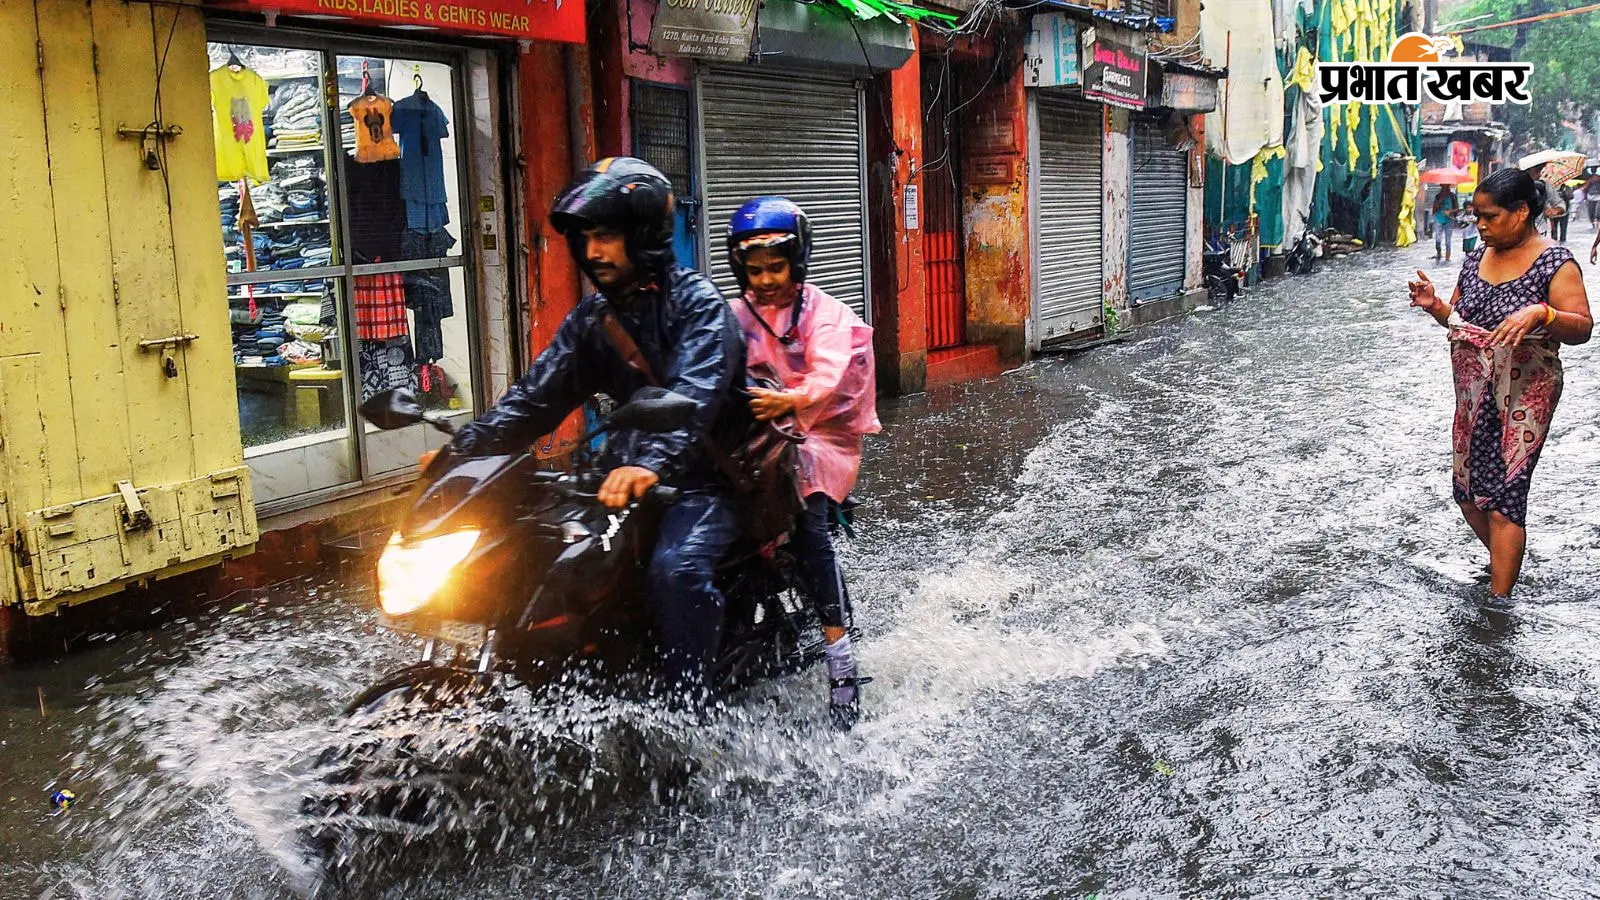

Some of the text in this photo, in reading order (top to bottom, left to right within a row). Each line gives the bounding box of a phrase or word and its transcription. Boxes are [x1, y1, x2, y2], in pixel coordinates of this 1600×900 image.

[424, 3, 434, 21] &
[438, 5, 486, 26] GENTS
[489, 11, 530, 32] WEAR
